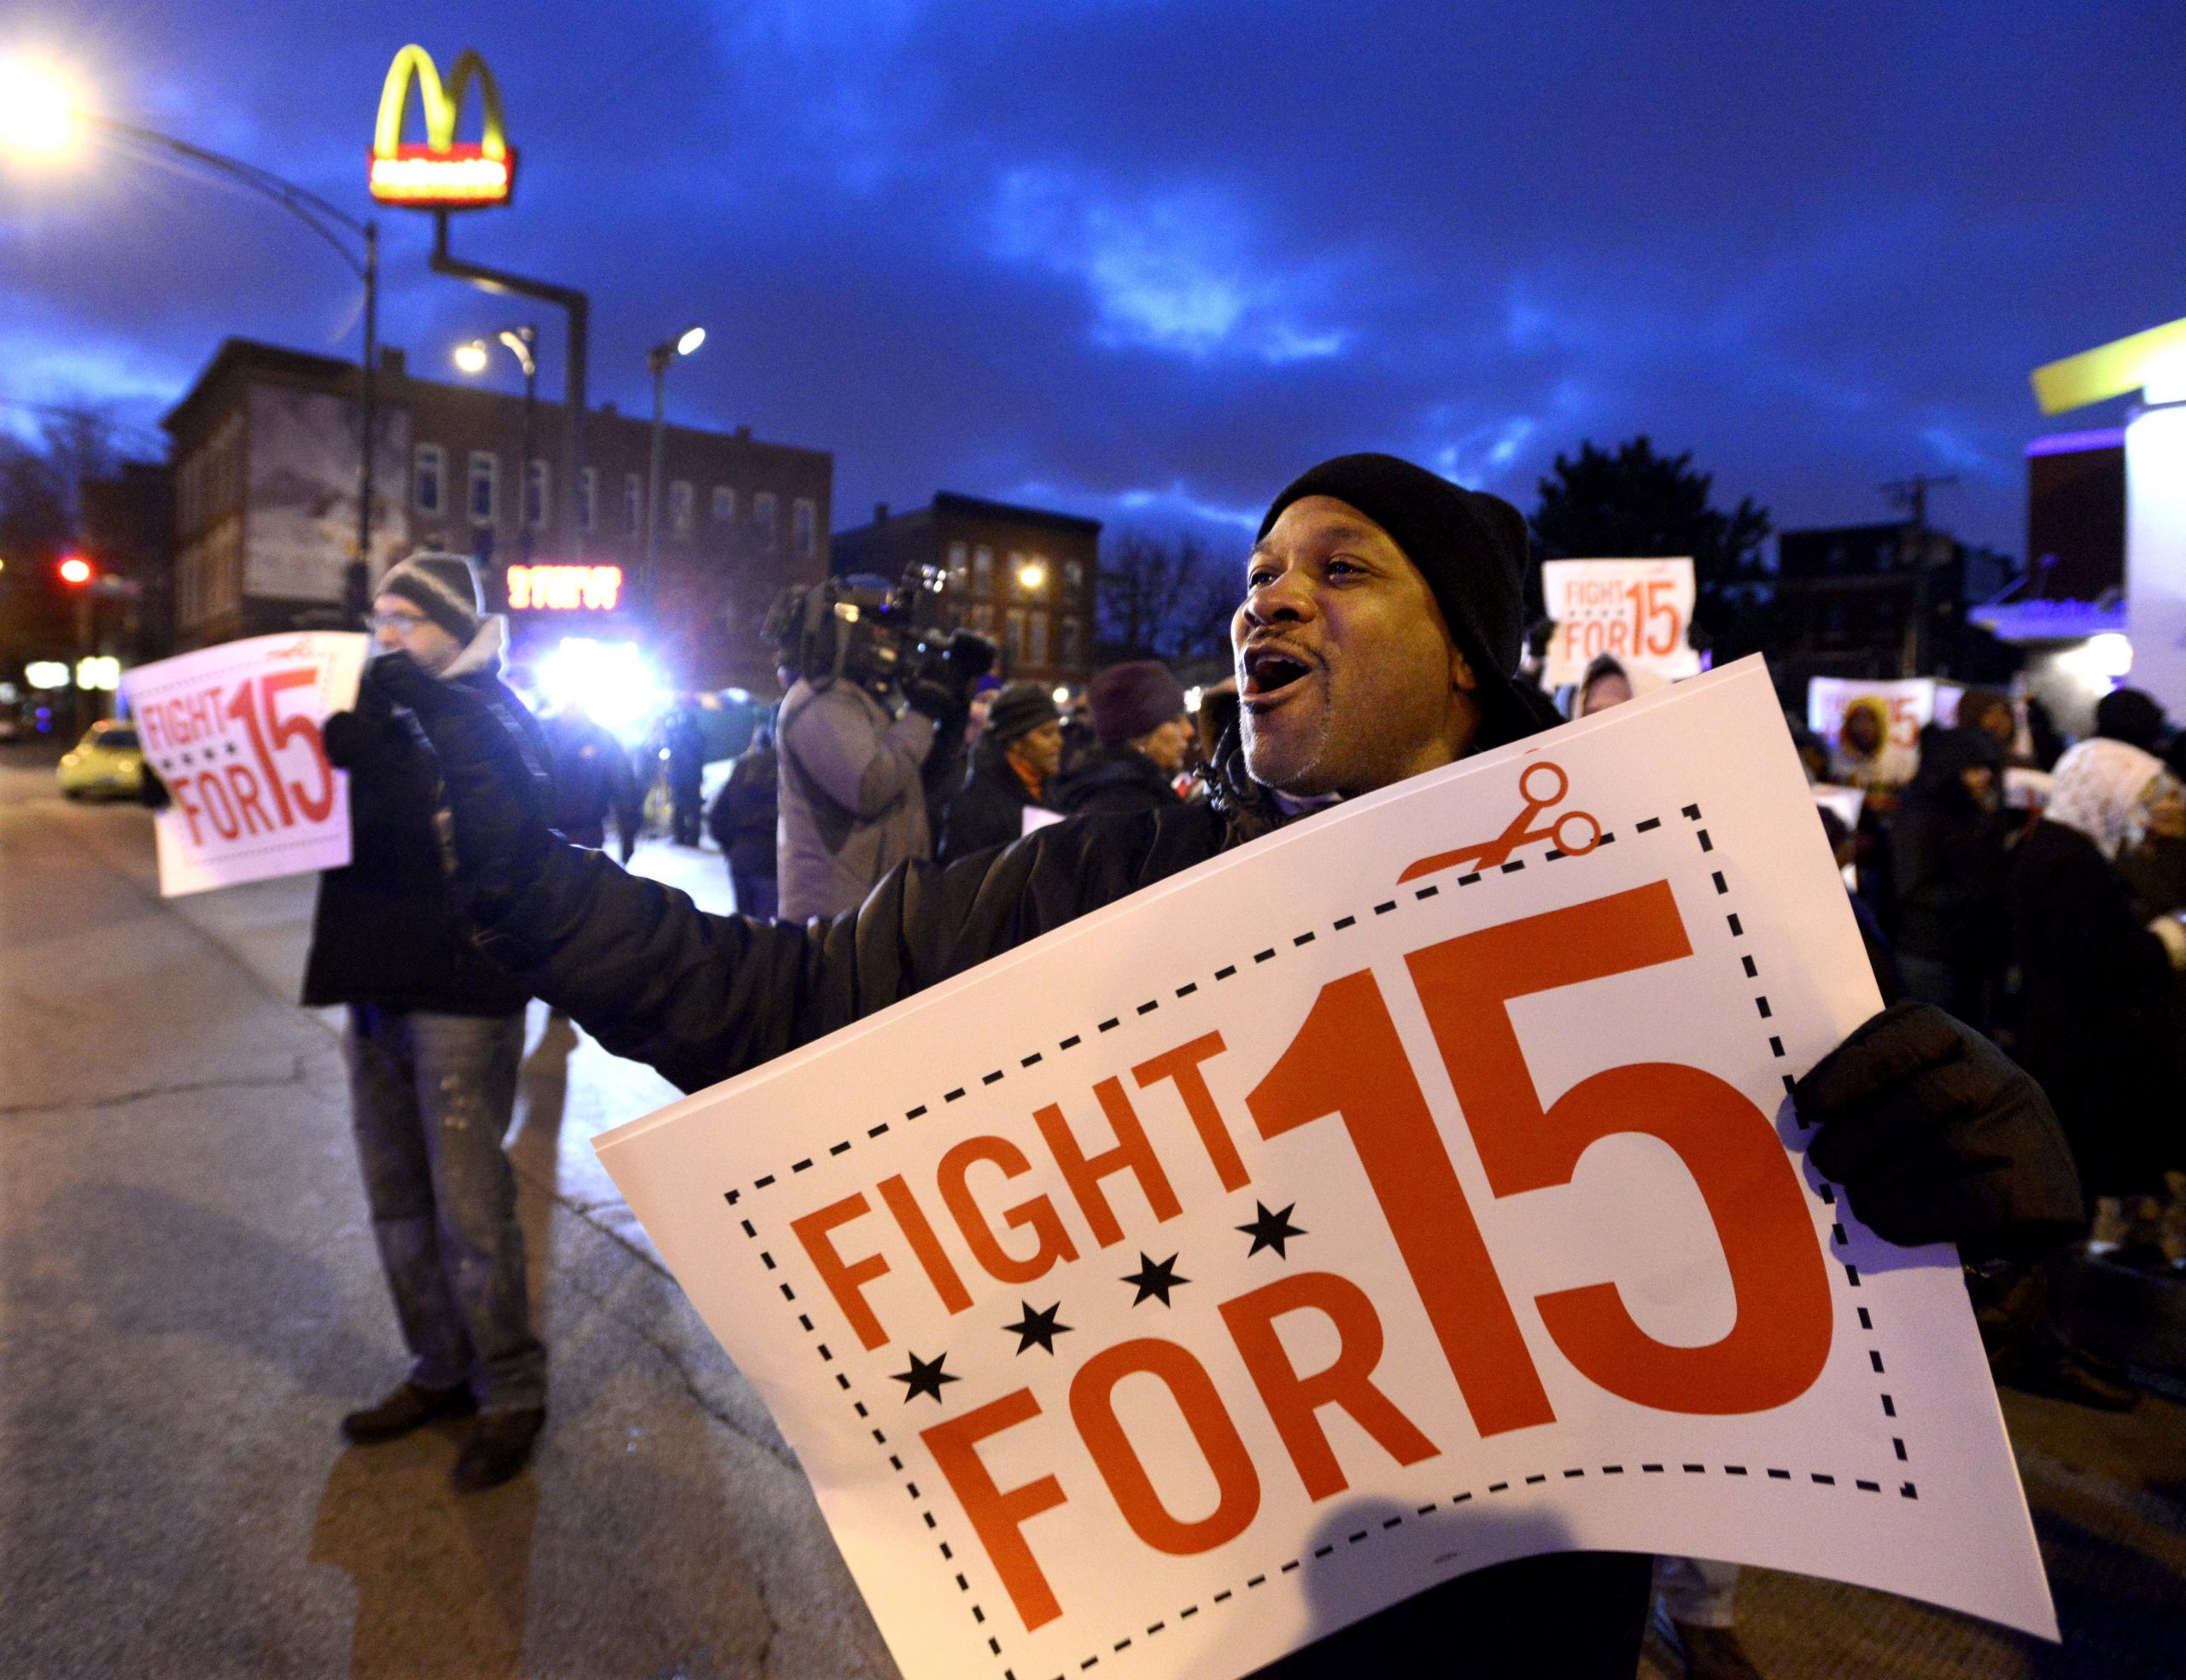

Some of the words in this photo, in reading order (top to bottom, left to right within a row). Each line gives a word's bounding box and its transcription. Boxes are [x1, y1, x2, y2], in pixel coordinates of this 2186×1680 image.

[1566, 580, 1623, 606] FIGHT
[1626, 580, 1681, 657] 15
[1566, 621, 1627, 660] FOR
[142, 685, 226, 750] FIGHT
[227, 668, 333, 828] 15
[172, 765, 274, 847] FOR
[791, 1030, 1252, 1351] FIGHT
[1245, 879, 1833, 1438] 15
[920, 1272, 1441, 1632] FOR
